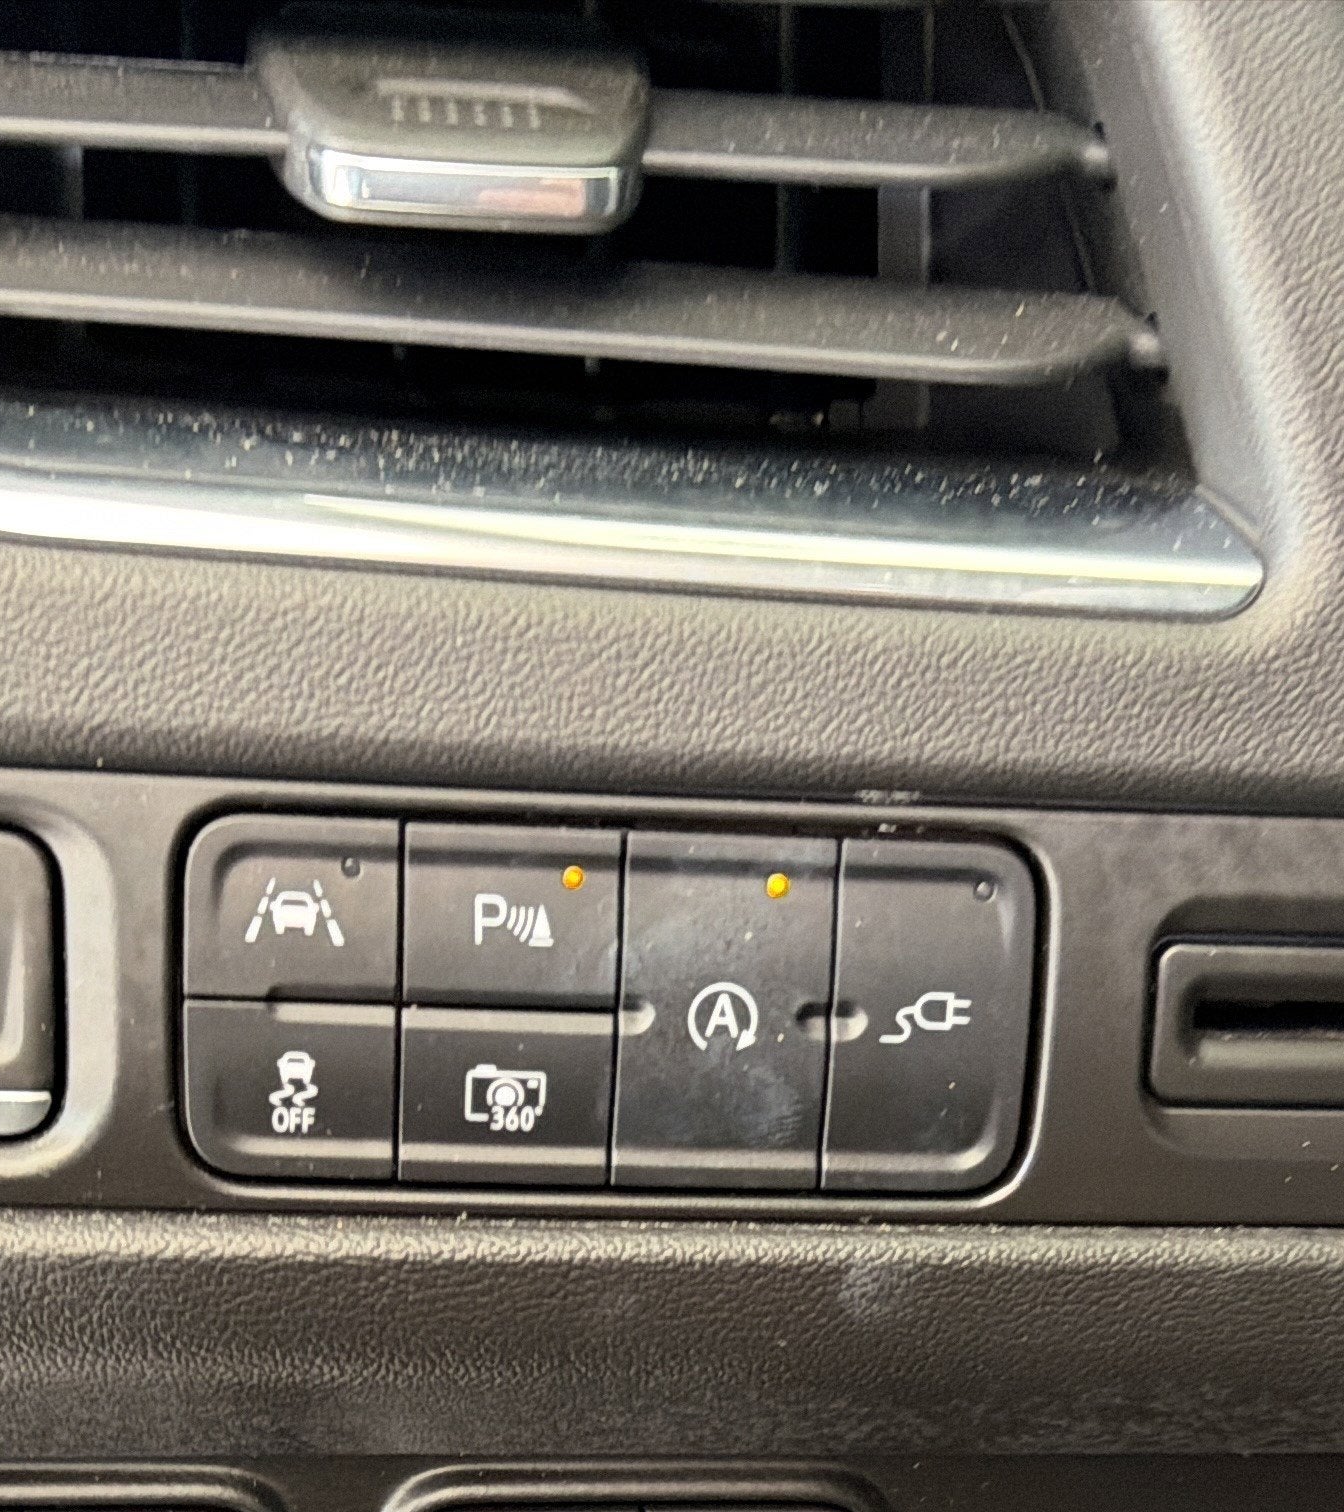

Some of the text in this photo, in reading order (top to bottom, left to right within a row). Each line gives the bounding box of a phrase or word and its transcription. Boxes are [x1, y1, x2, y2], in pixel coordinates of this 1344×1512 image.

[697, 989, 745, 1041] A
[271, 1105, 316, 1134] OFF
[487, 1106, 536, 1132] 360
